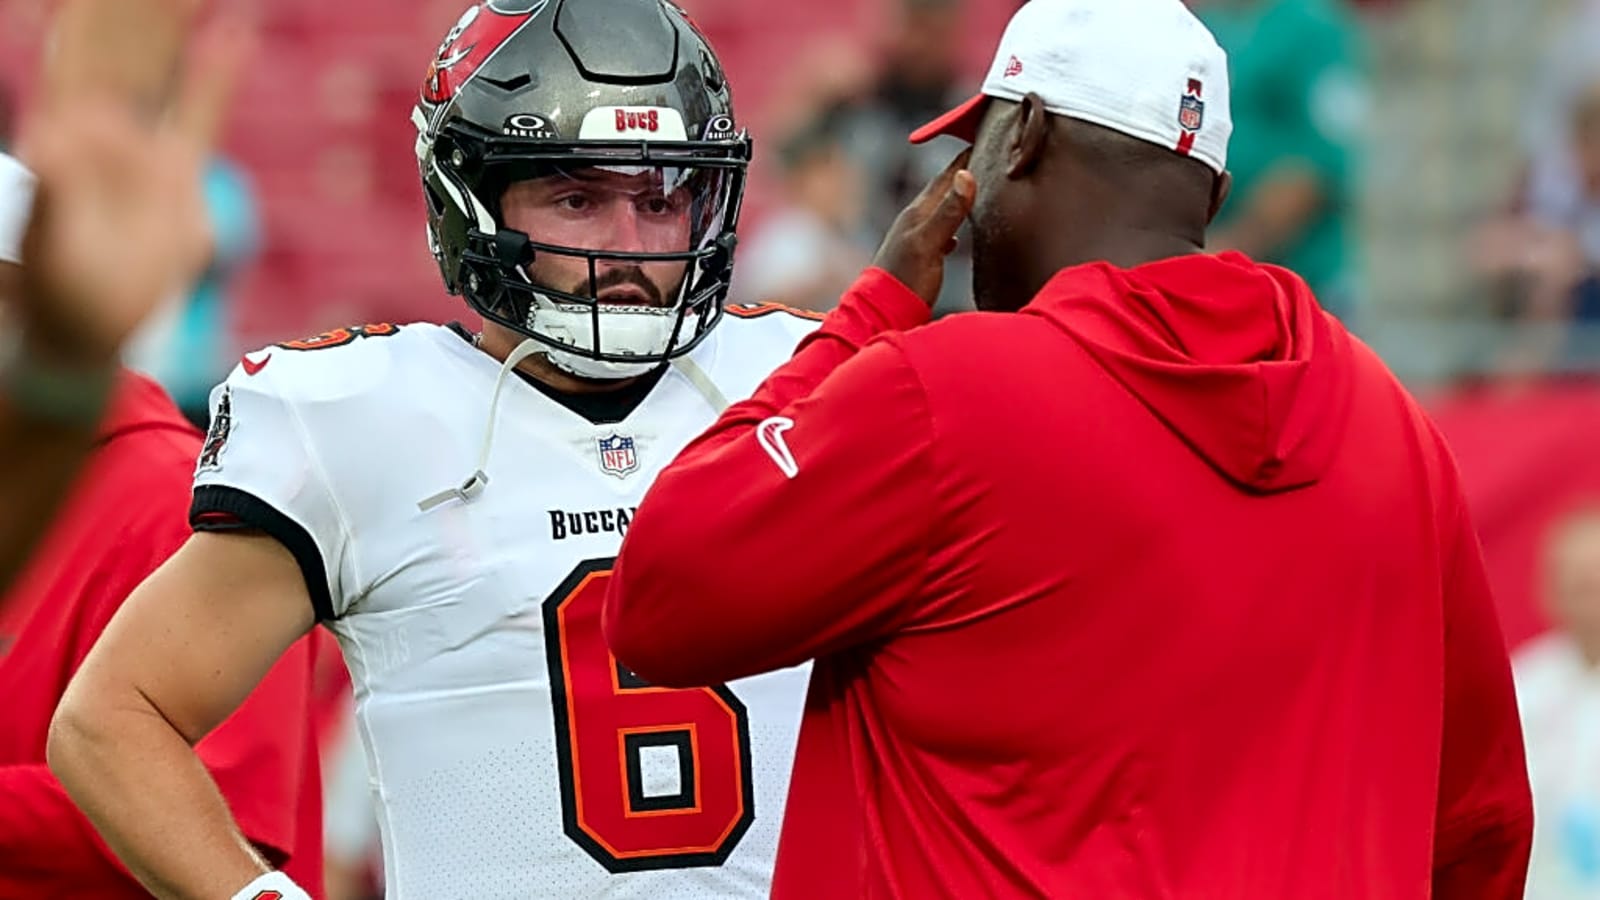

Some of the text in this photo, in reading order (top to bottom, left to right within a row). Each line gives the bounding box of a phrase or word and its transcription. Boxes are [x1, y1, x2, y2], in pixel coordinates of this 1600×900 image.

[503, 128, 554, 138] OAKLEY
[605, 450, 634, 469] NFL
[542, 557, 755, 873] 6
